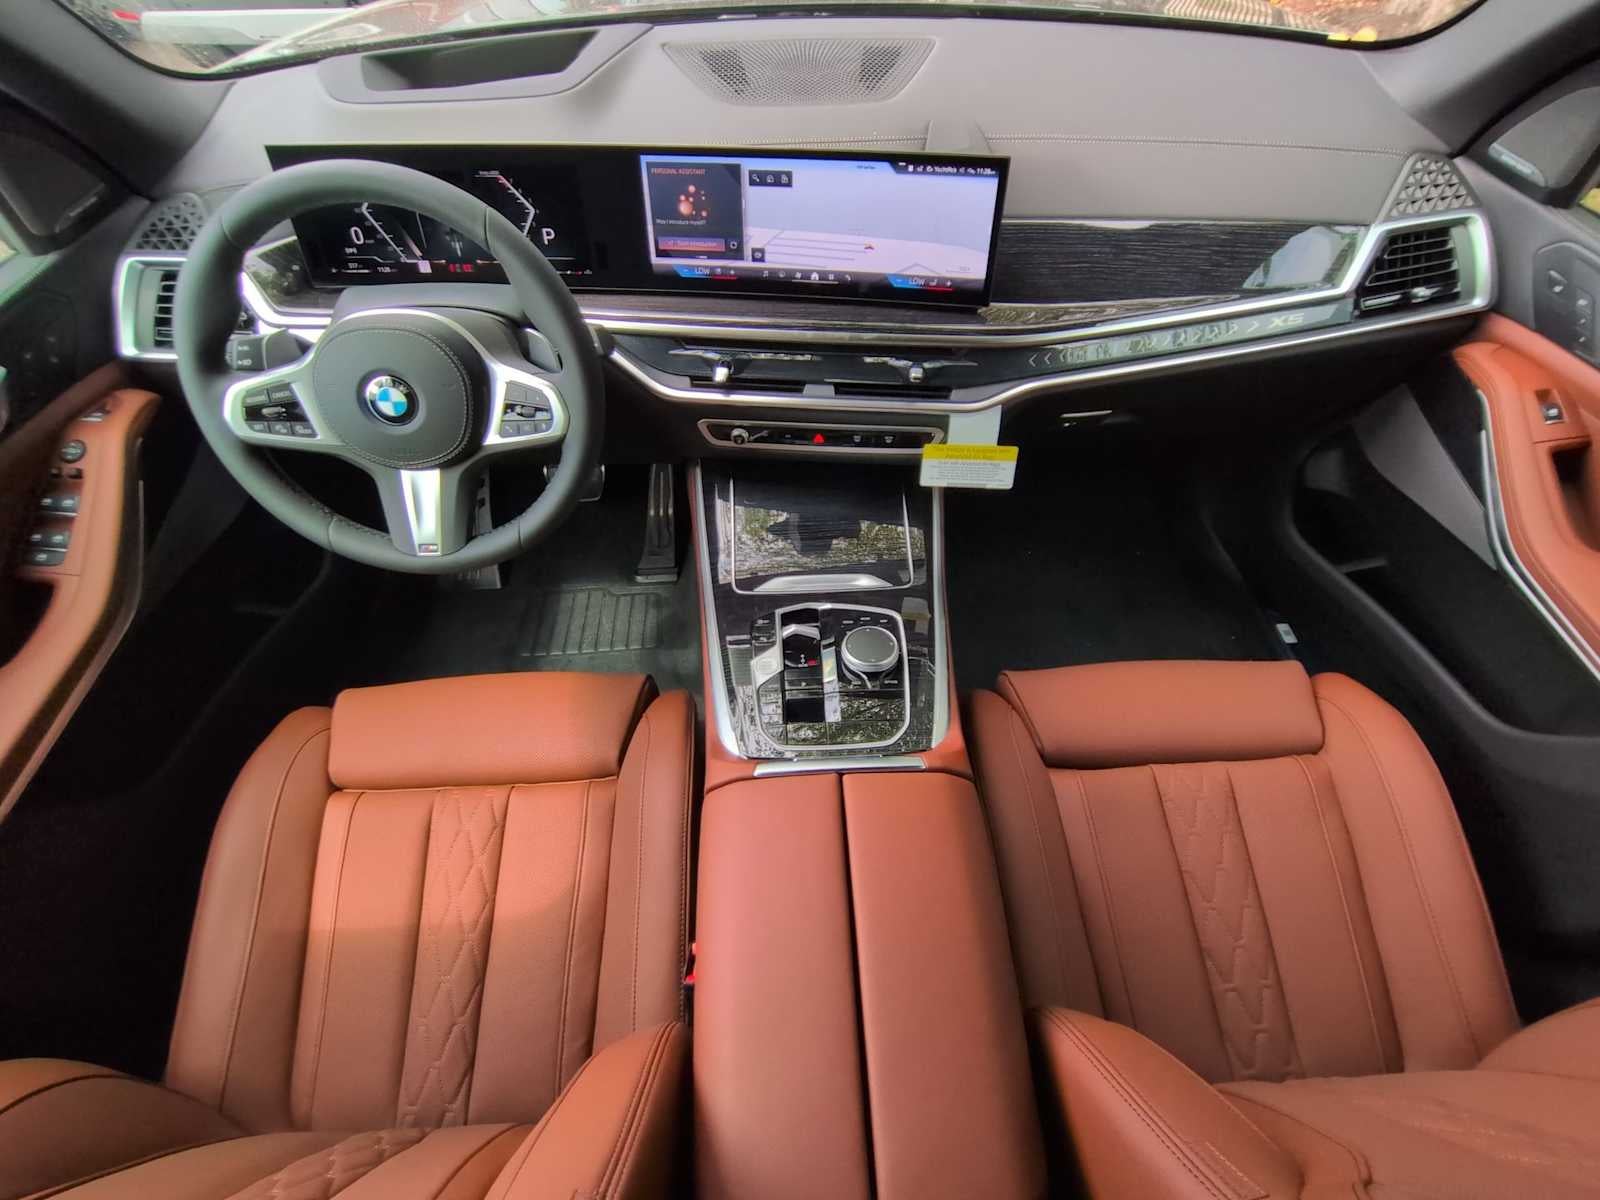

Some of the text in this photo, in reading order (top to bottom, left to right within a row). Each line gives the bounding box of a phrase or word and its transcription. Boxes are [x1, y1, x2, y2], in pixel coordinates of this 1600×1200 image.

[351, 226, 365, 245] 0
[541, 227, 556, 246] P
[908, 276, 926, 287] LOW
[1268, 313, 1304, 328] X5
